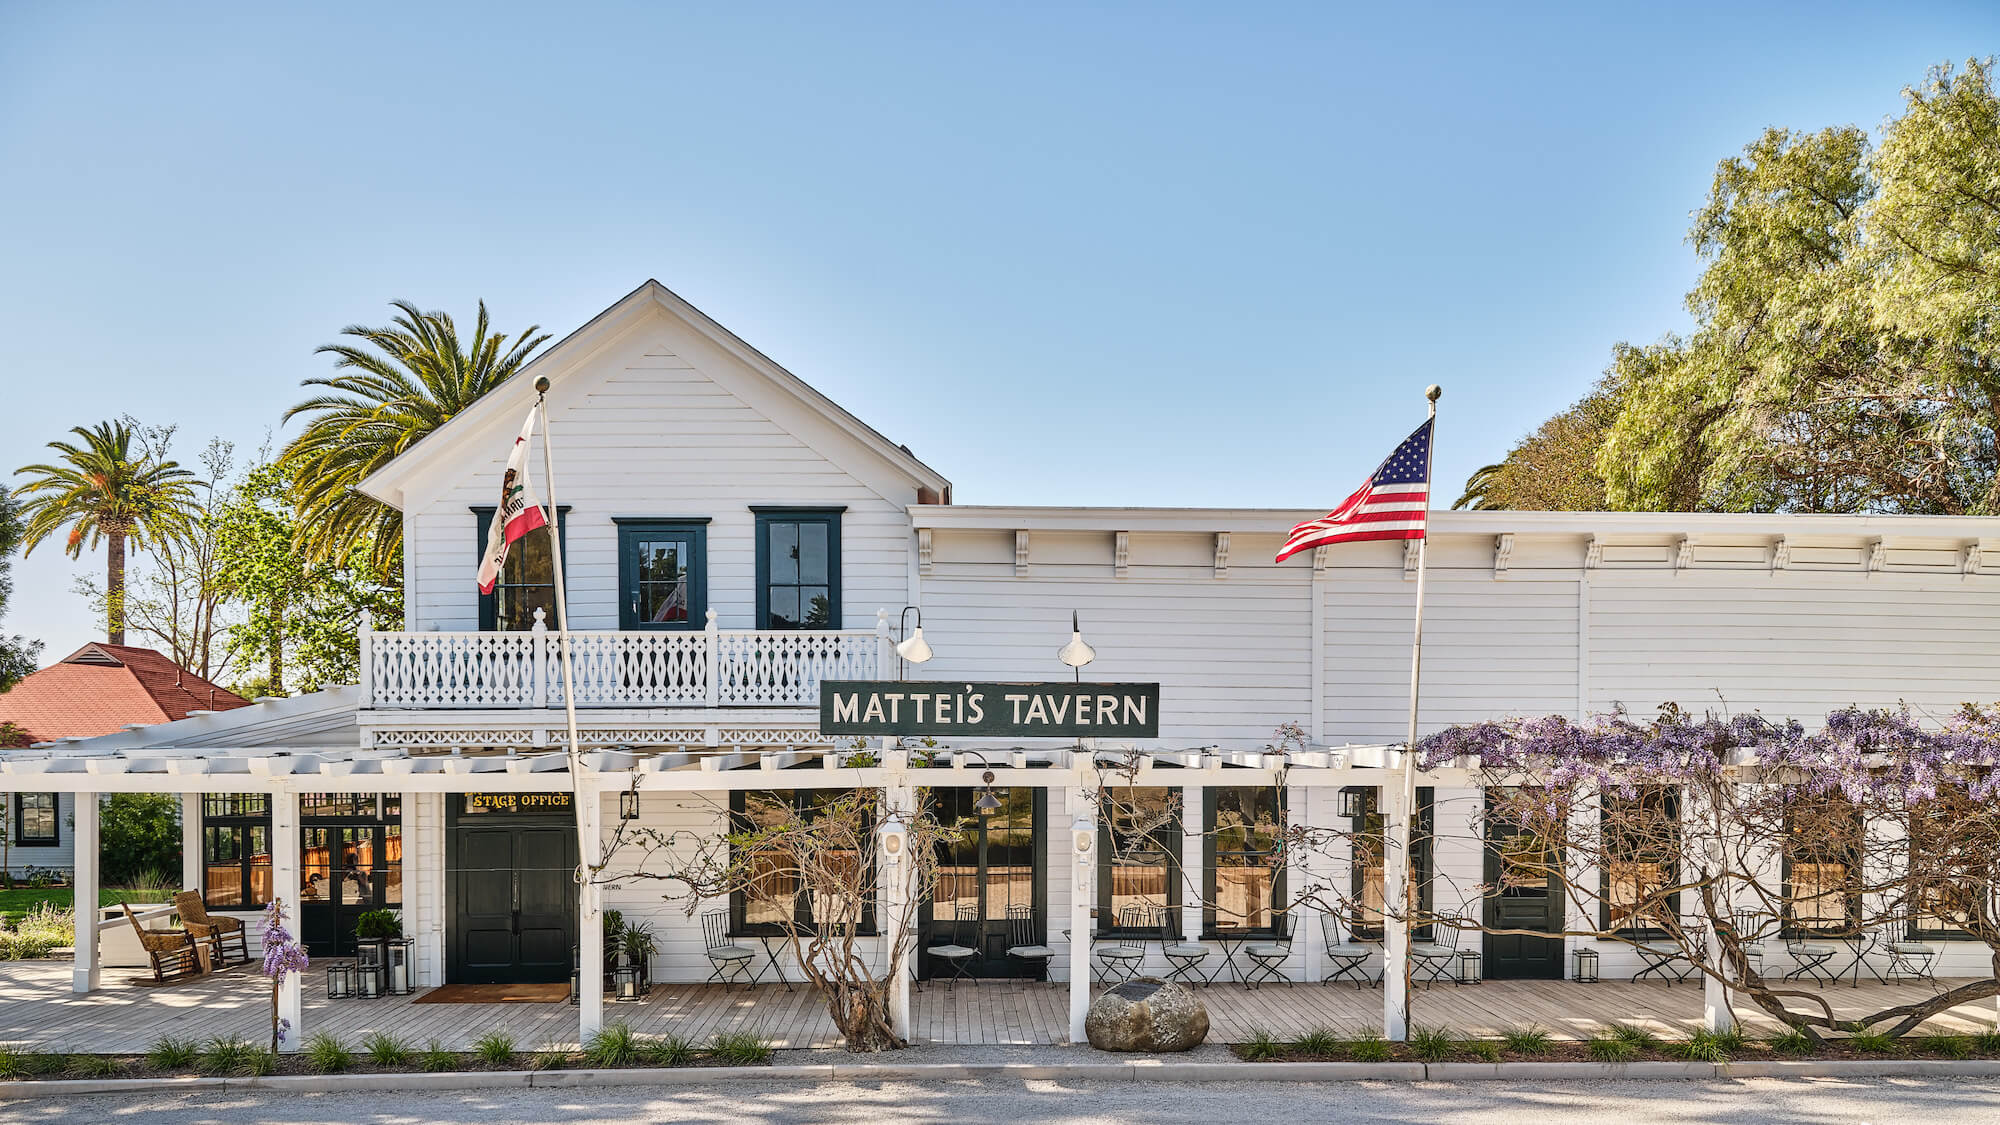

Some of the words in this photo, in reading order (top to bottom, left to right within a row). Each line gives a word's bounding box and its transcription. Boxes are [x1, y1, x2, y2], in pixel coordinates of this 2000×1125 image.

[832, 684, 985, 725] MATTEI'S
[1004, 694, 1147, 725] TAVERN
[473, 794, 517, 809] STAGE
[521, 795, 569, 806] OFFICE
